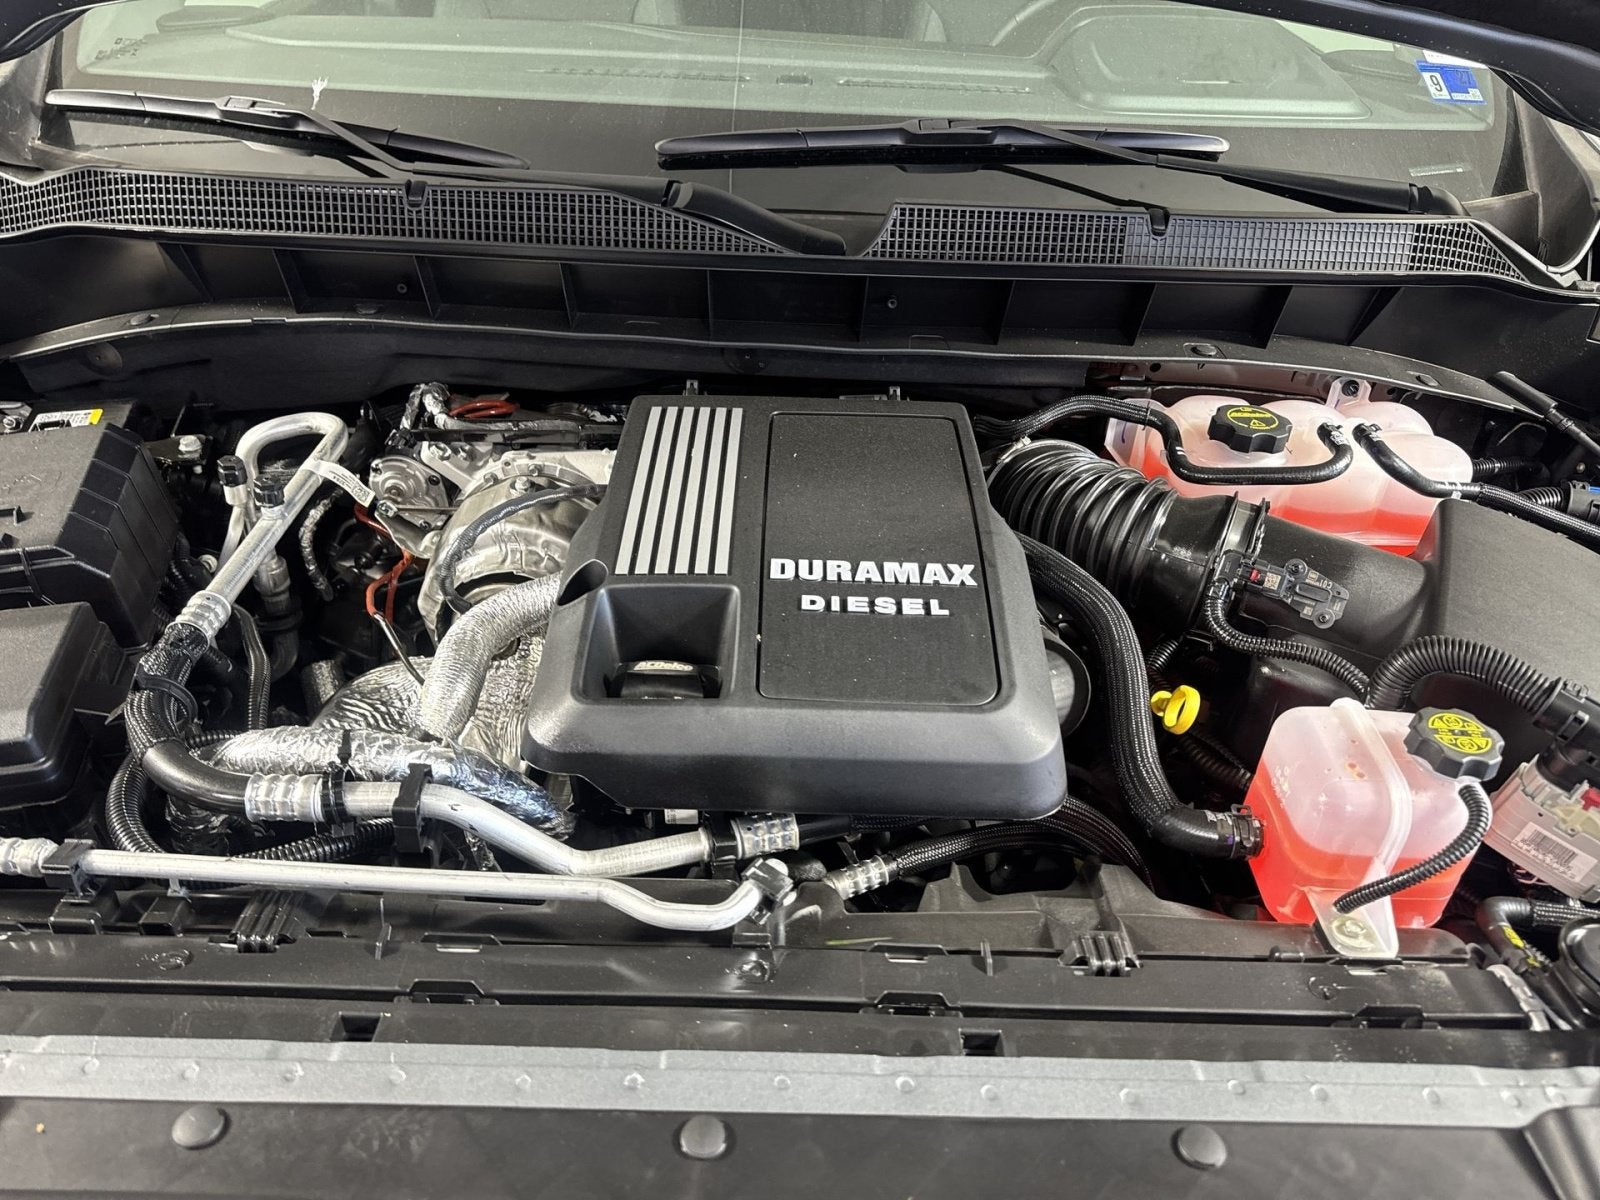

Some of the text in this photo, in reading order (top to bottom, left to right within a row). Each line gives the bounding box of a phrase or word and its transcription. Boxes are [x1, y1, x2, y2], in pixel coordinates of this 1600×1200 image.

[1430, 75, 1443, 92] 9
[769, 558, 978, 587] DURAMAX
[801, 594, 950, 616] DIESEL
